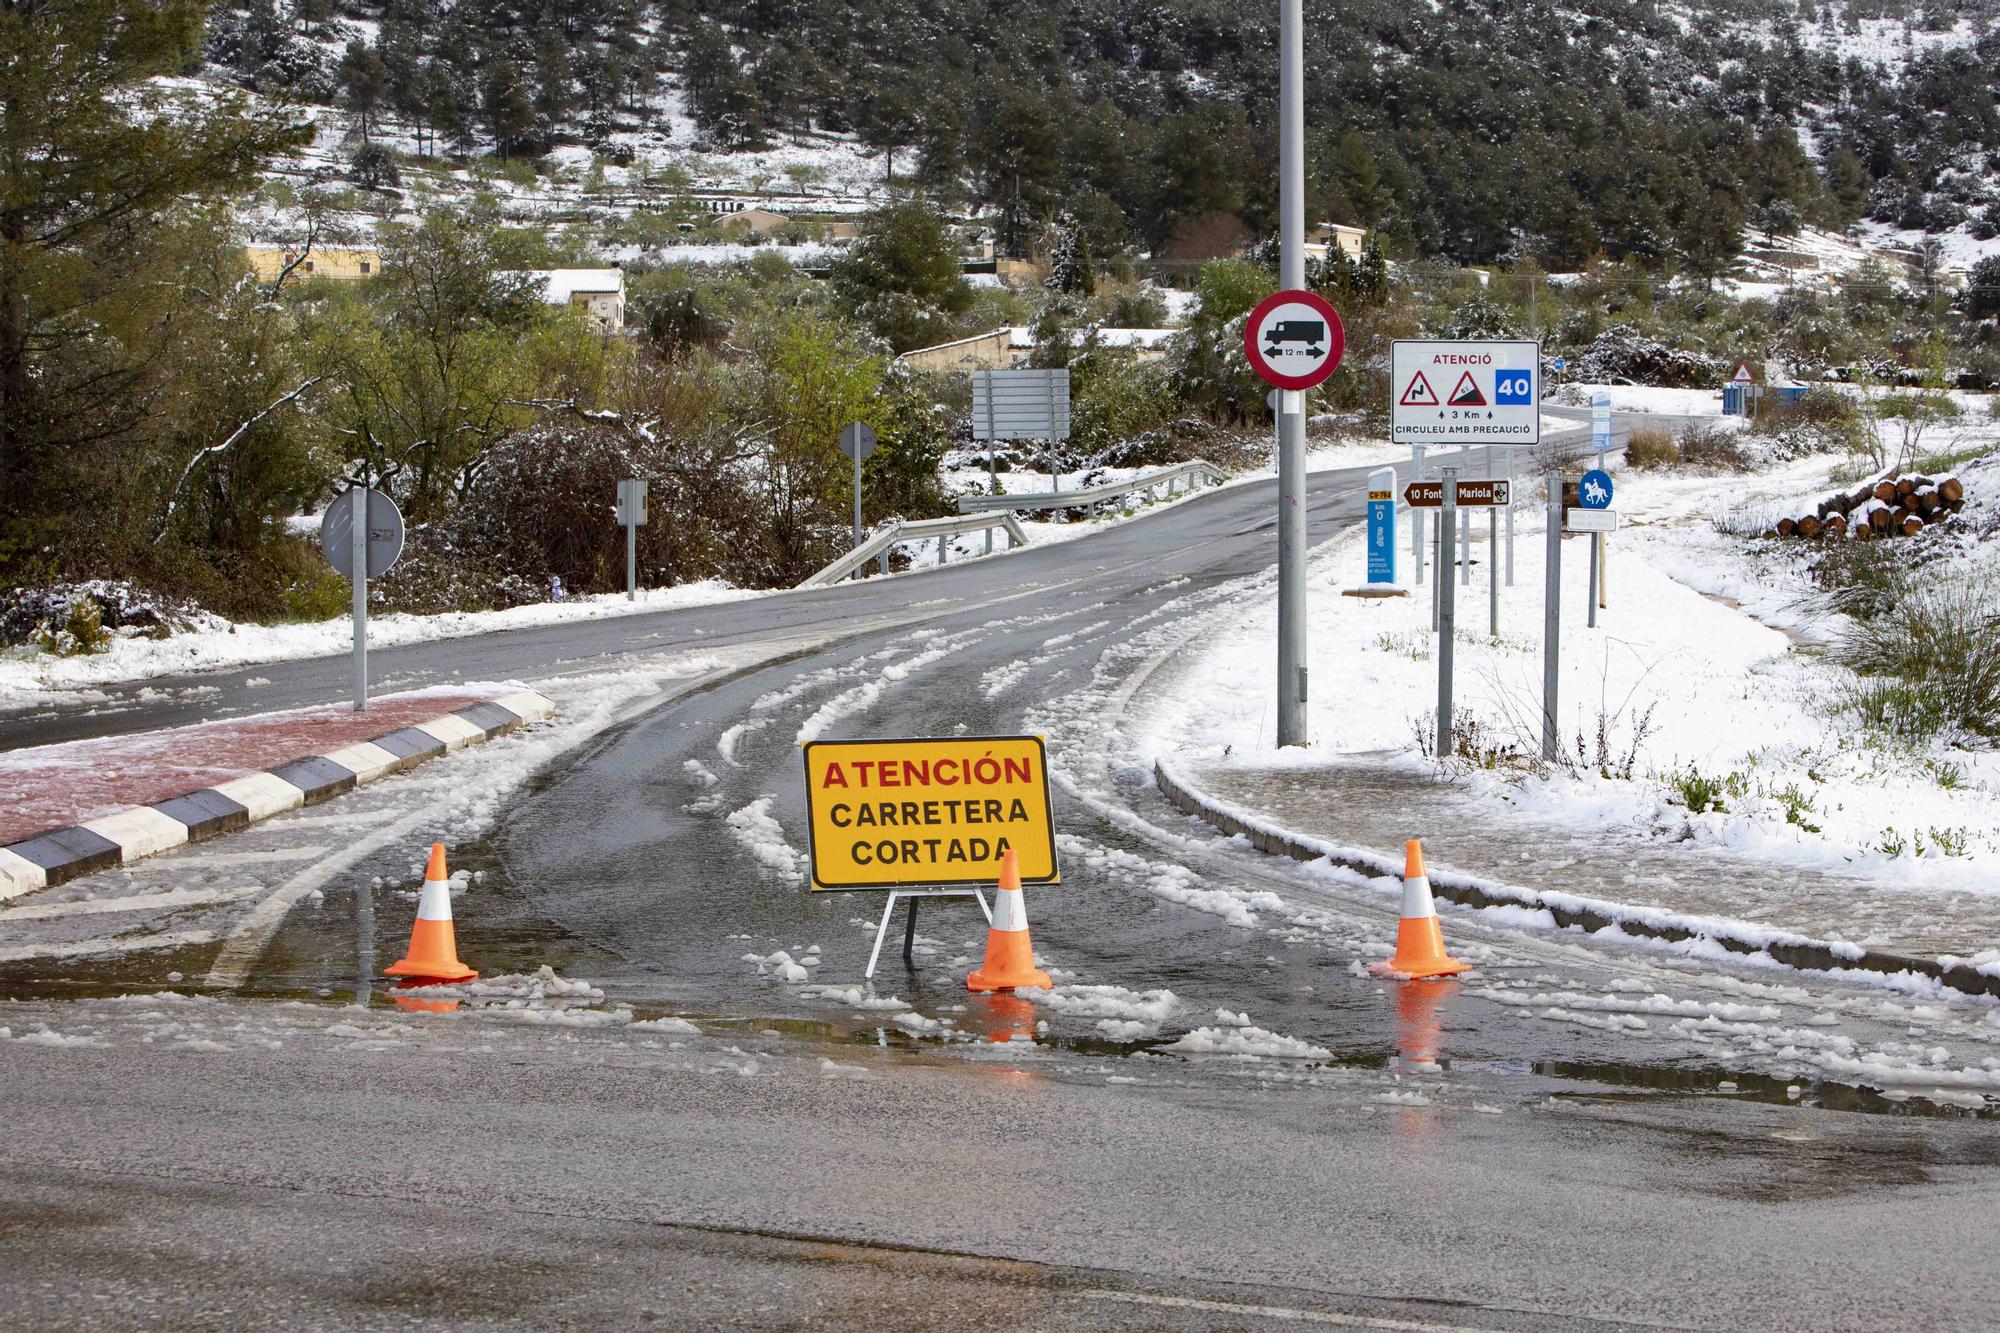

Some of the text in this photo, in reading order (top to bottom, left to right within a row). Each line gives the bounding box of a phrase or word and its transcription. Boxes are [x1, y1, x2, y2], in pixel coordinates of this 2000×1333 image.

[1285, 348, 1294, 356] 12
[1433, 353, 1492, 364] ATENCIÓ
[1498, 378, 1529, 396] 40
[1452, 411, 1480, 419] 3 Km
[1395, 424, 1530, 434] CIRCULEU AMB PRECAUCIÓ
[1410, 490, 1420, 499] 10
[1459, 488, 1491, 498] Mariola
[1376, 510, 1384, 521] 0
[822, 751, 1032, 789] ATENCIÓN
[830, 798, 1029, 828] CARRETERA
[851, 837, 1011, 866] CORTADA
